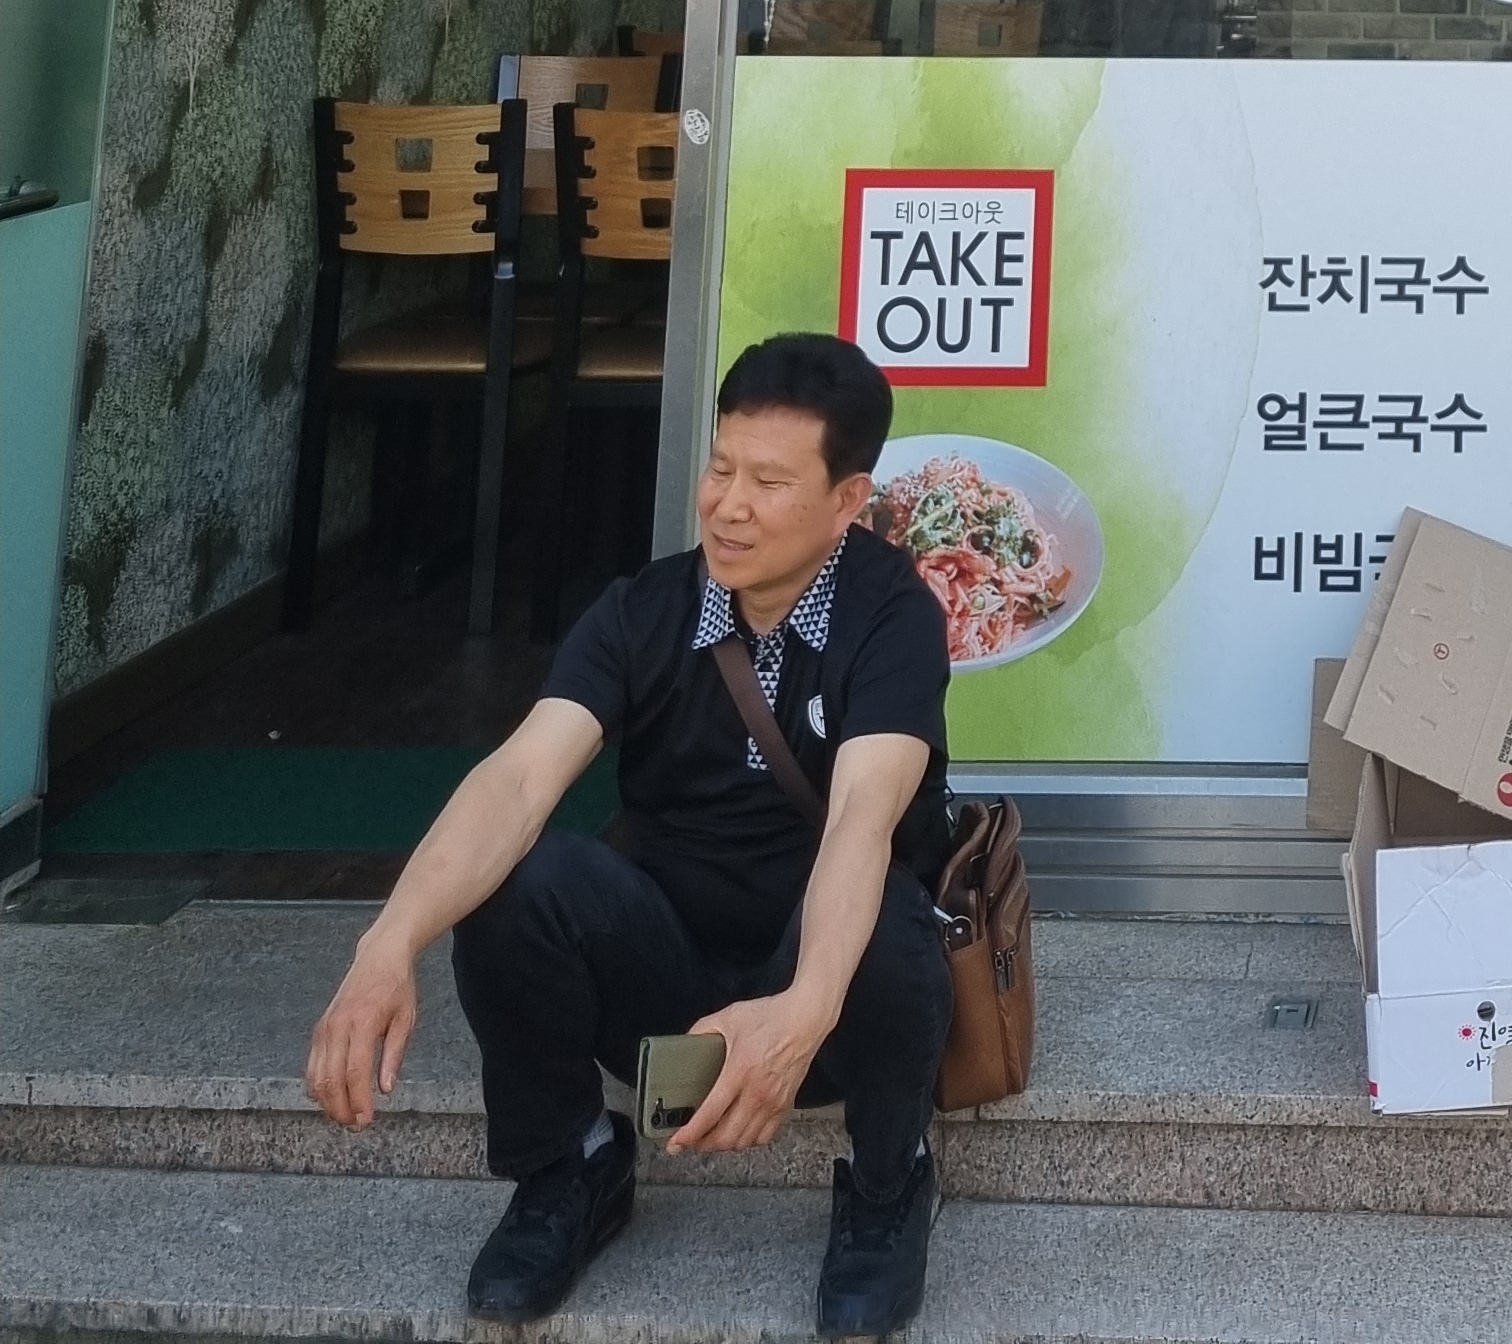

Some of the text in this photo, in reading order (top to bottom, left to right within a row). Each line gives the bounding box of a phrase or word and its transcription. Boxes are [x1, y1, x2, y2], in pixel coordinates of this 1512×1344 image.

[895, 200, 1004, 225] 테이크아웃
[870, 231, 1025, 287] TAKE
[1258, 255, 1490, 315] 잔치국수
[876, 296, 1015, 354] OUT
[1256, 392, 1488, 454] 얼큰국수
[1254, 532, 1395, 593] 비빔
